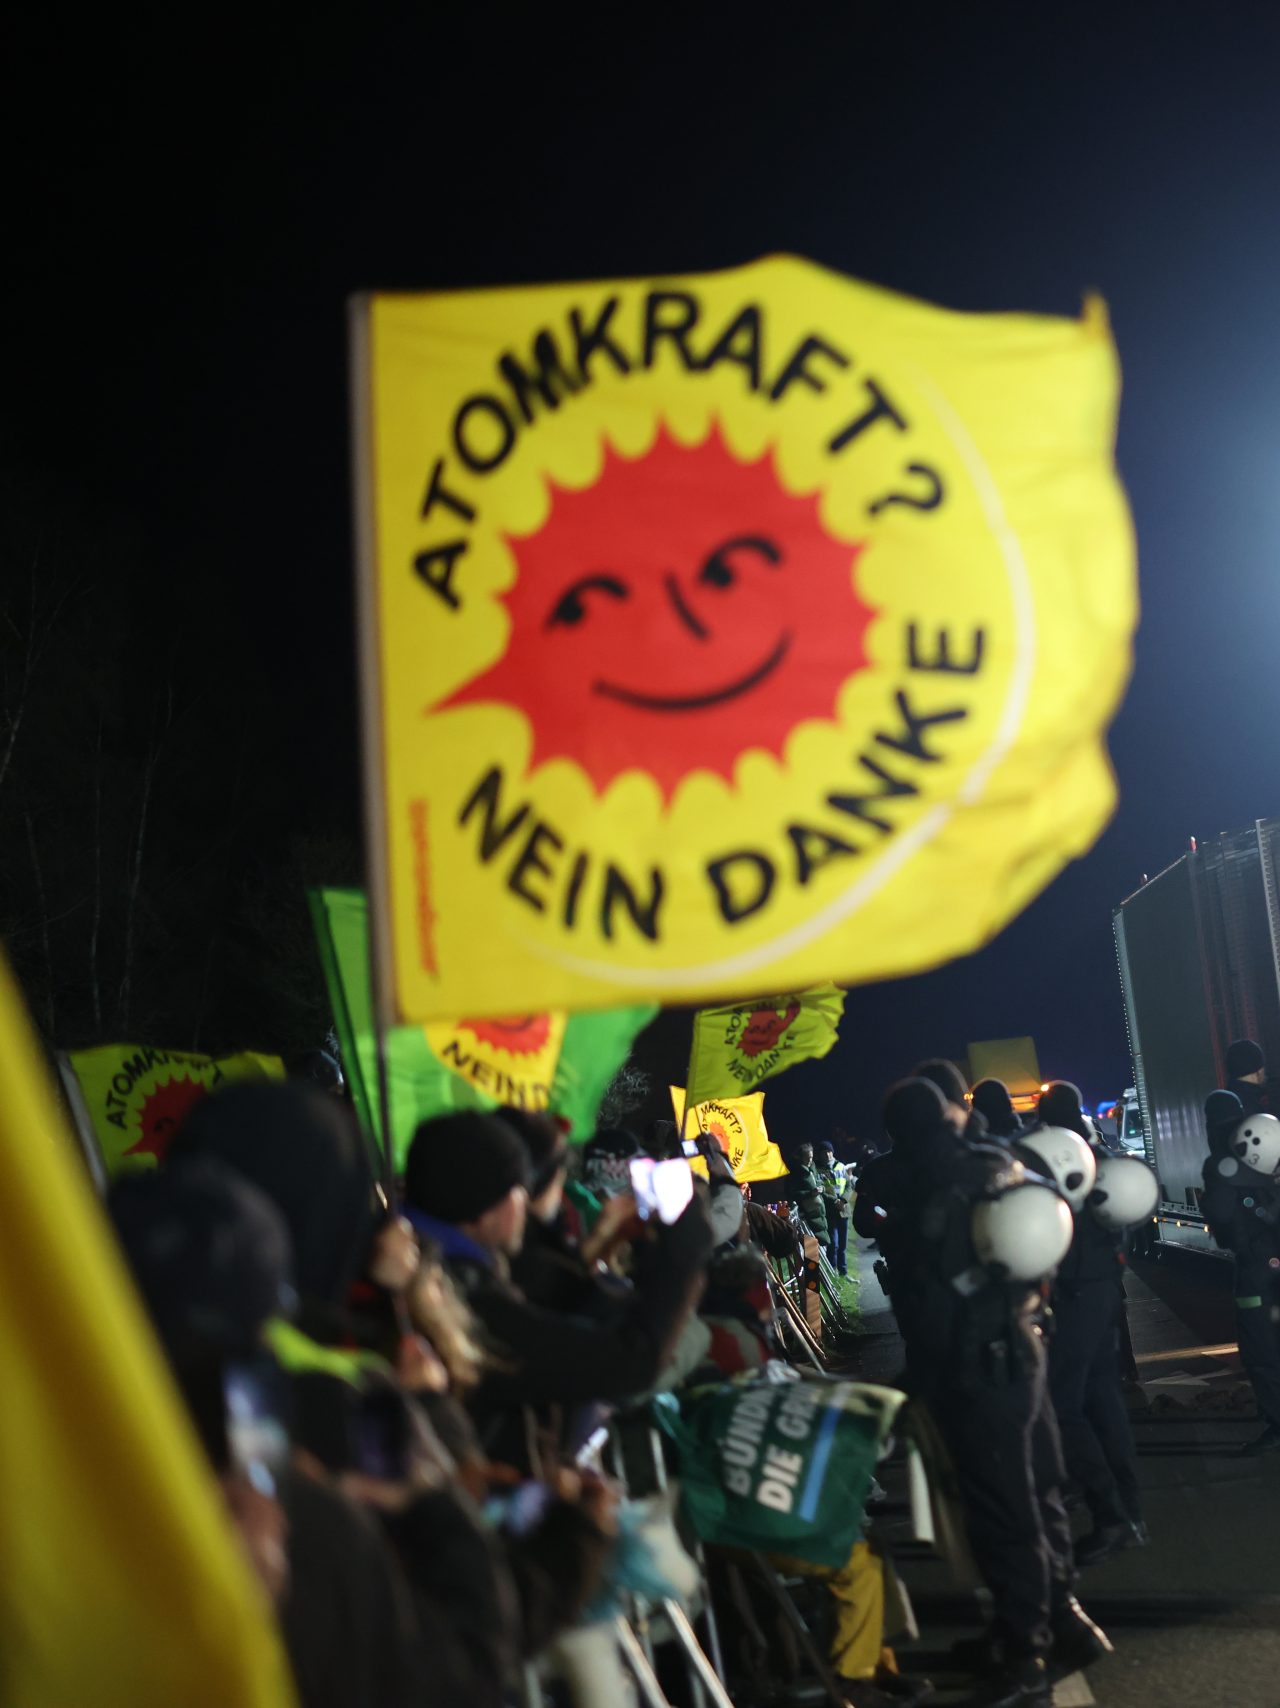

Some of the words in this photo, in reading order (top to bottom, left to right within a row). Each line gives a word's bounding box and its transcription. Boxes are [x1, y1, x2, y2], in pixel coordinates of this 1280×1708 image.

[411, 288, 945, 612] ATOMKRAFT?
[457, 763, 667, 943] NEIN
[706, 620, 986, 925] DANKE
[756, 1445, 803, 1514] DIE
